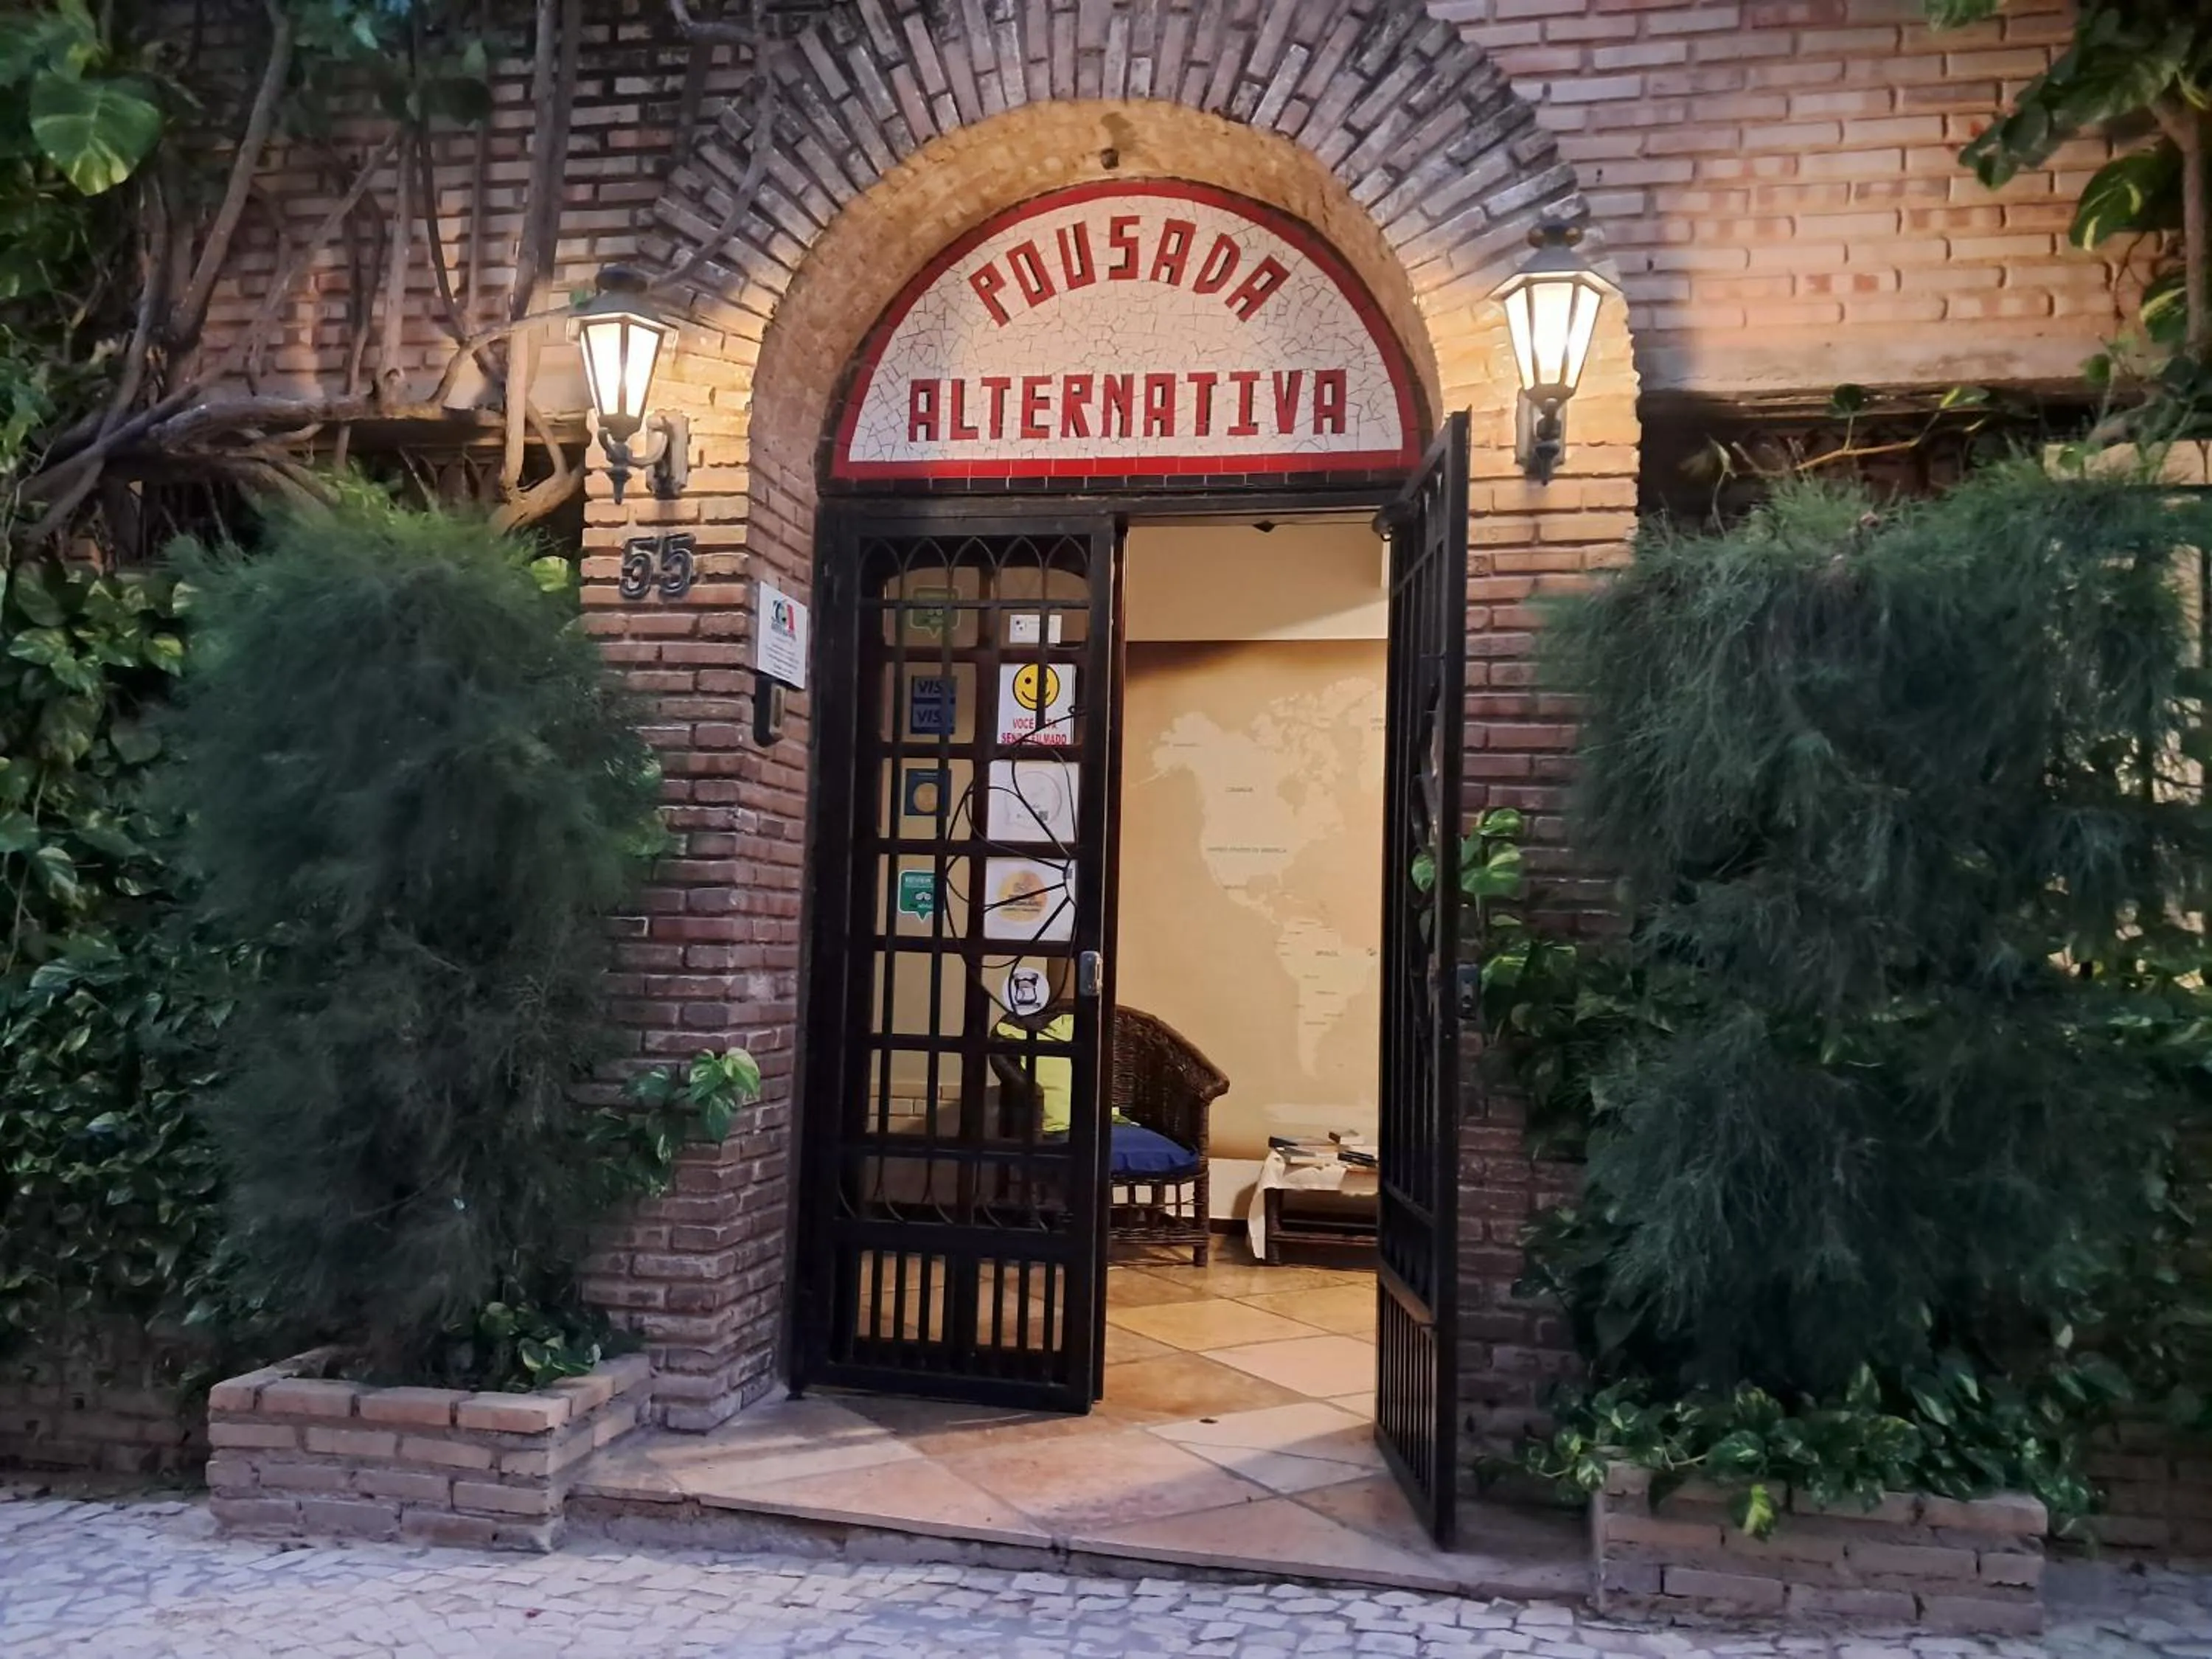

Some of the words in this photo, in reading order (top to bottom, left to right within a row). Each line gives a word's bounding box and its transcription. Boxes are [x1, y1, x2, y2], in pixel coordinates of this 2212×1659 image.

[967, 215, 1290, 327] POUSADA
[908, 369, 1346, 441] ALTERNATIVA
[619, 532, 696, 600] 55
[915, 709, 953, 723] VIS
[917, 678, 954, 694] VIS
